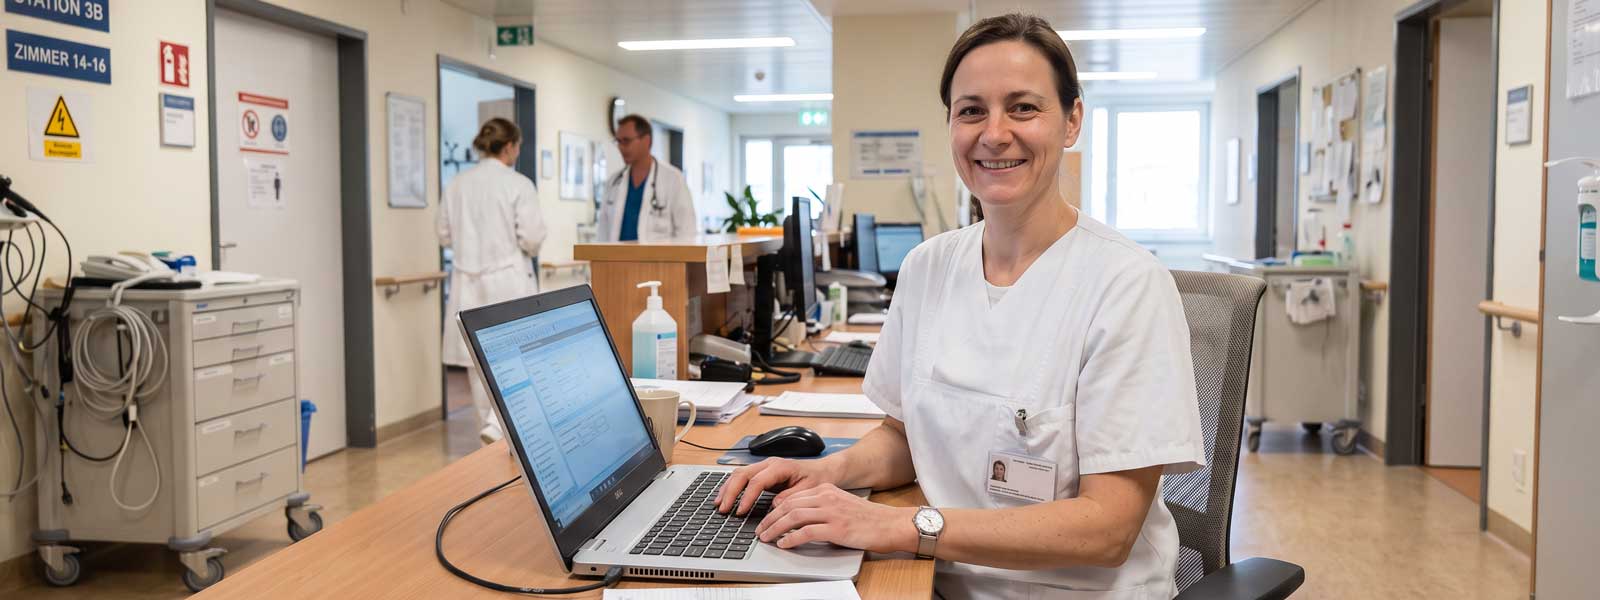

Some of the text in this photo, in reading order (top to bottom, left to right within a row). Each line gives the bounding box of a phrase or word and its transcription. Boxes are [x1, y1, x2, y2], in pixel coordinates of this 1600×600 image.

[15, 0, 103, 20] ATION 3B
[14, 43, 106, 73] ZIMMER 14-16
